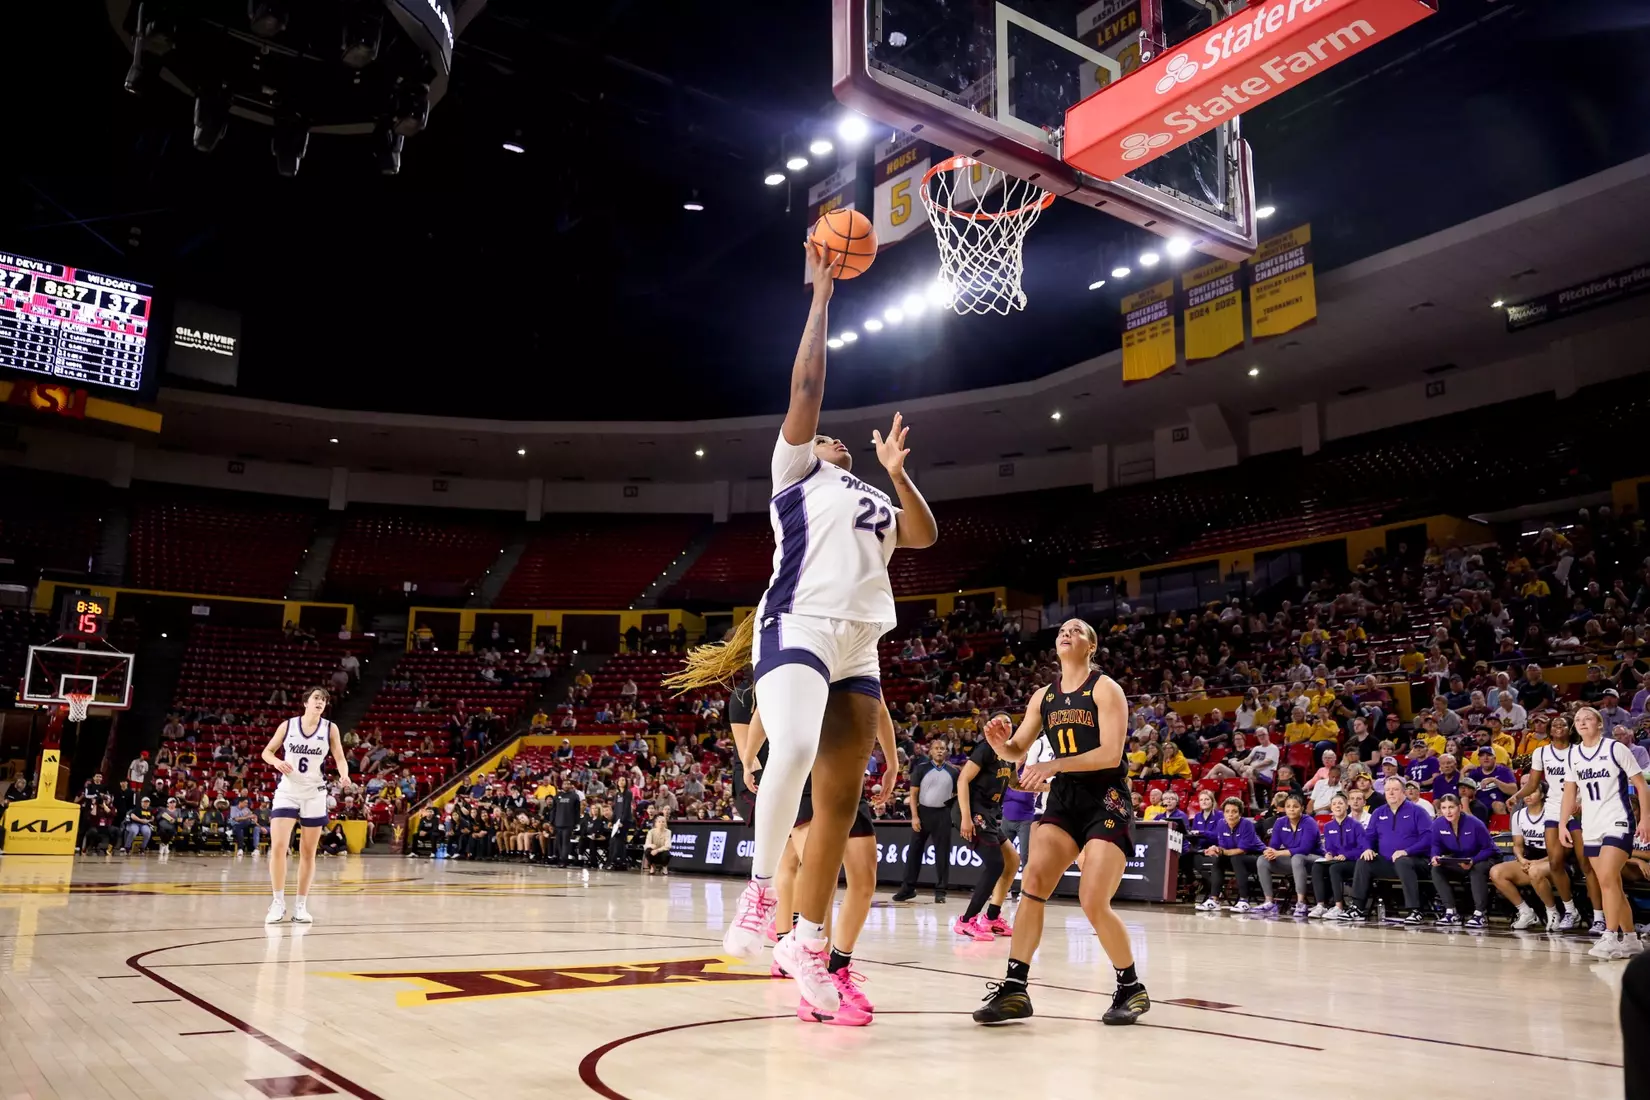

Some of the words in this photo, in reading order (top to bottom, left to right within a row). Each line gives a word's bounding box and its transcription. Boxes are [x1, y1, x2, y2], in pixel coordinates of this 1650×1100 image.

[1096, 9, 1137, 48] LEVER
[886, 148, 917, 175] HOUSE
[890, 178, 913, 227] 5
[16, 258, 52, 273] DEVILS
[1255, 248, 1305, 273] CONFERENCE
[1255, 257, 1306, 282] CHAMPIONS
[44, 280, 89, 301] 8:37
[87, 274, 137, 292] WILDCATS
[1189, 274, 1234, 297] CONFERENCE
[1558, 277, 1617, 304] Pitchfork
[108, 294, 139, 314] 37
[1189, 283, 1235, 307] CHAMPIONS
[1126, 300, 1167, 321] CONFERENCE
[1126, 308, 1168, 330] CHAMPIONS
[1189, 306, 1210, 321] 2024
[176, 326, 202, 339] GILA
[203, 332, 234, 346] RIVER
[854, 496, 892, 544] 22
[77, 600, 102, 615] 8:36
[79, 614, 97, 634] 15
[289, 742, 323, 756] Wildcats
[1057, 728, 1078, 754] 11
[298, 757, 309, 774] 6
[1576, 767, 1611, 781] Wildcats
[1586, 781, 1601, 801] 11
[11, 819, 74, 833] KIA
[677, 834, 697, 844] RIVER
[712, 836, 724, 844] YOU
[710, 852, 721, 860] YOU
[885, 844, 898, 863] &
